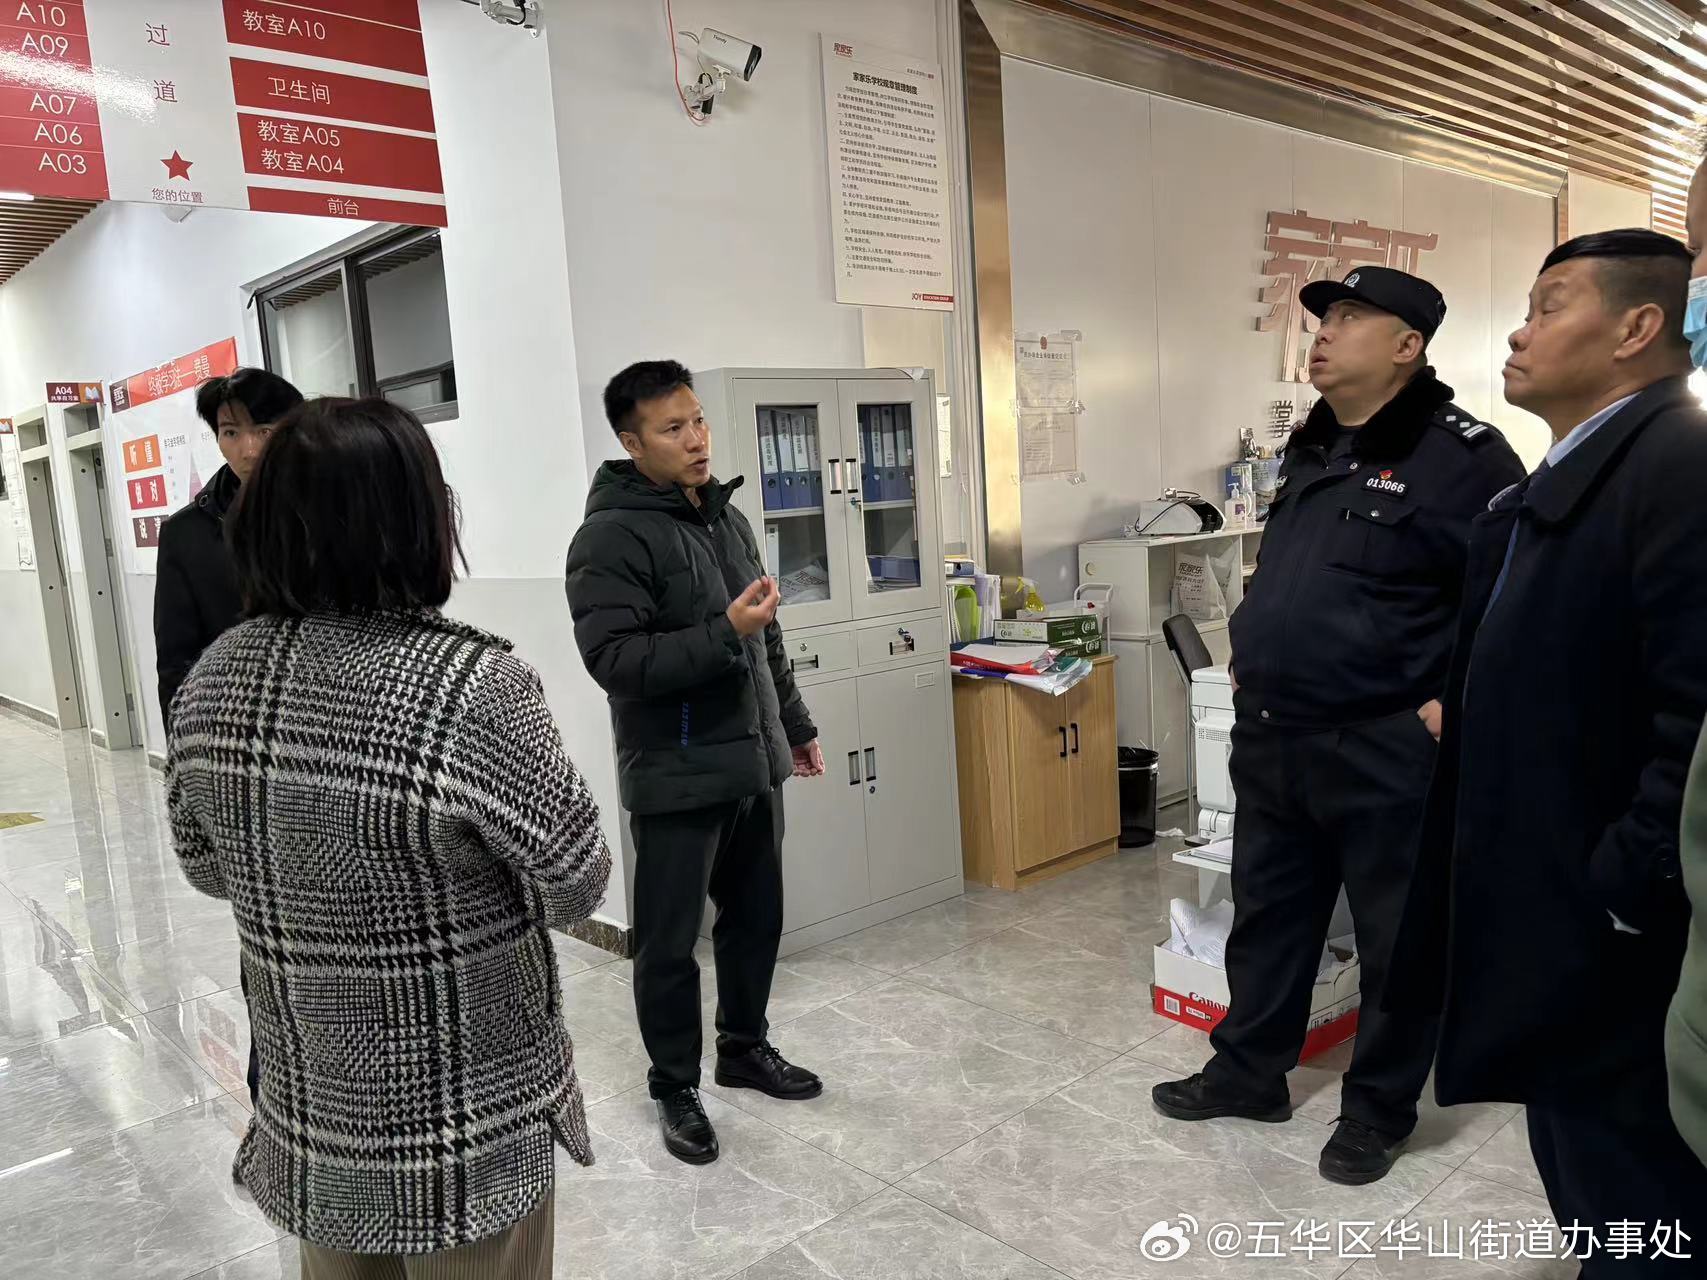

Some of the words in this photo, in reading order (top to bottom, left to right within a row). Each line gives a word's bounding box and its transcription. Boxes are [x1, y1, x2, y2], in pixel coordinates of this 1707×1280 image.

[16, 3, 66, 28] A10
[242, 9, 327, 41] 教室A10
[21, 34, 69, 57] A09
[267, 76, 331, 105] 卫生间
[852, 71, 918, 95] 家家乐学校规章管理制度
[30, 94, 76, 116] A07
[34, 126, 83, 147] A06
[257, 120, 341, 148] 教室A05
[38, 152, 87, 175] A03
[261, 149, 345, 175] 教室A04
[151, 188, 204, 205] 您的位置
[328, 199, 360, 217] 前台
[55, 387, 73, 395] A04
[1366, 478, 1405, 493] 013066
